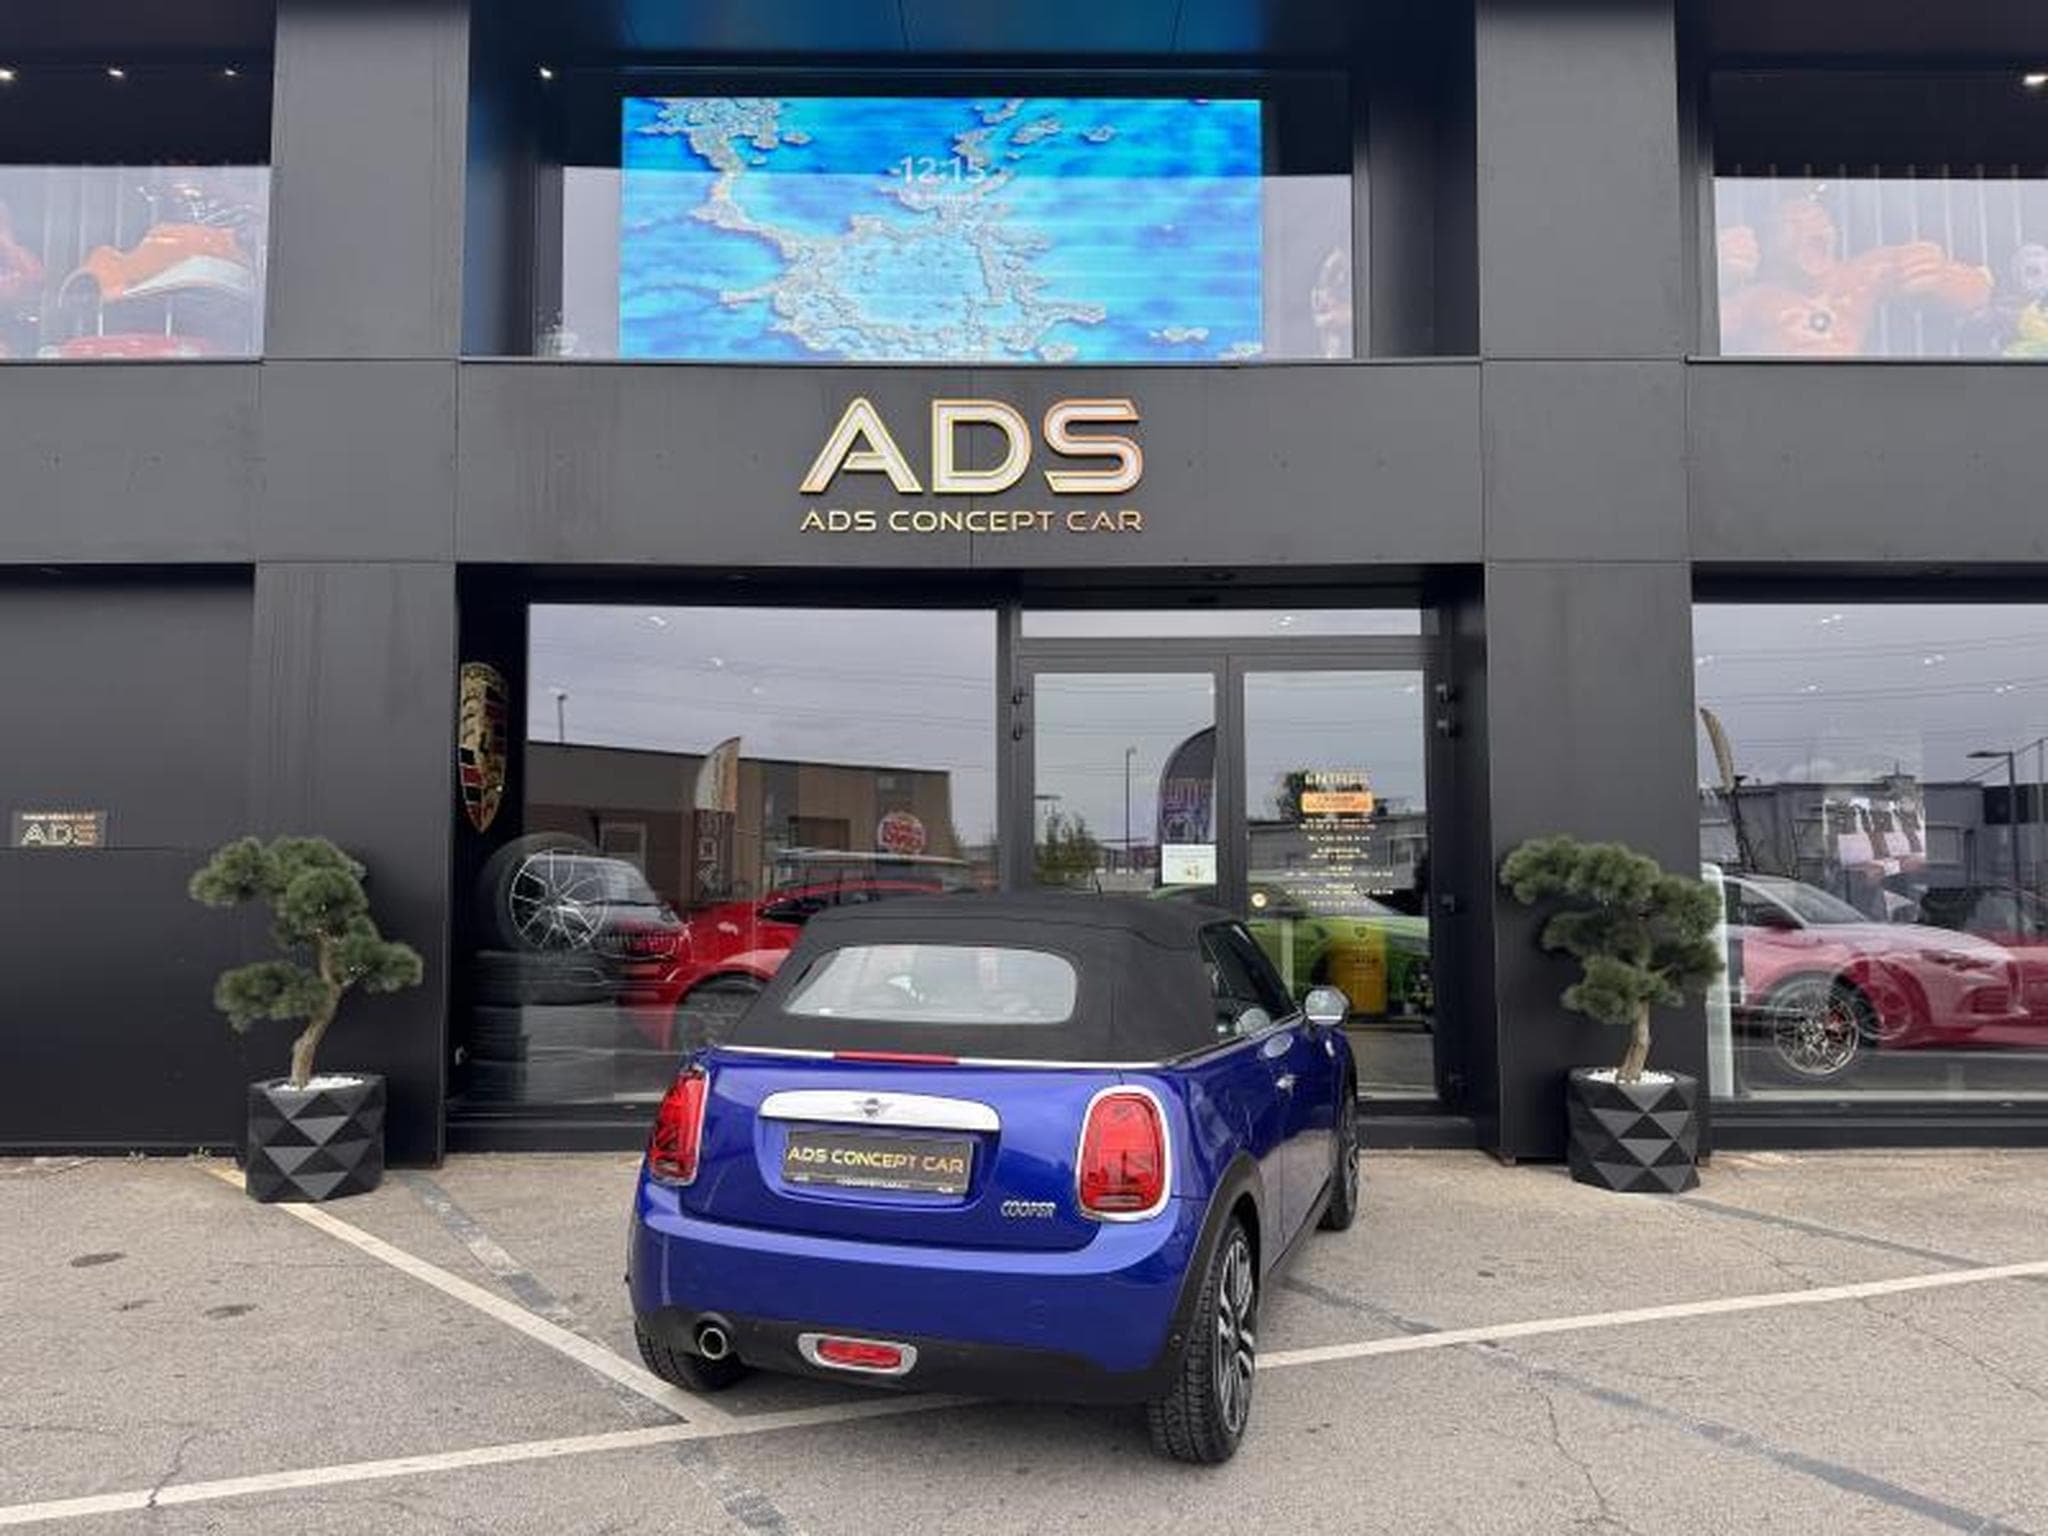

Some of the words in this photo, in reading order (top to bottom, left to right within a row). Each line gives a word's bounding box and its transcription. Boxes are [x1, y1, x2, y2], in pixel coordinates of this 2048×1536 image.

[900, 155, 986, 182] 12:15
[799, 397, 1144, 494] ADS
[800, 510, 877, 532] ADS
[889, 510, 1055, 533] CONCEPT
[1066, 510, 1144, 533] CAR
[788, 1145, 827, 1164] ADS
[831, 1148, 916, 1170] CONCEPT
[923, 1154, 964, 1173] CAR
[1000, 1200, 1057, 1219] COOPER
